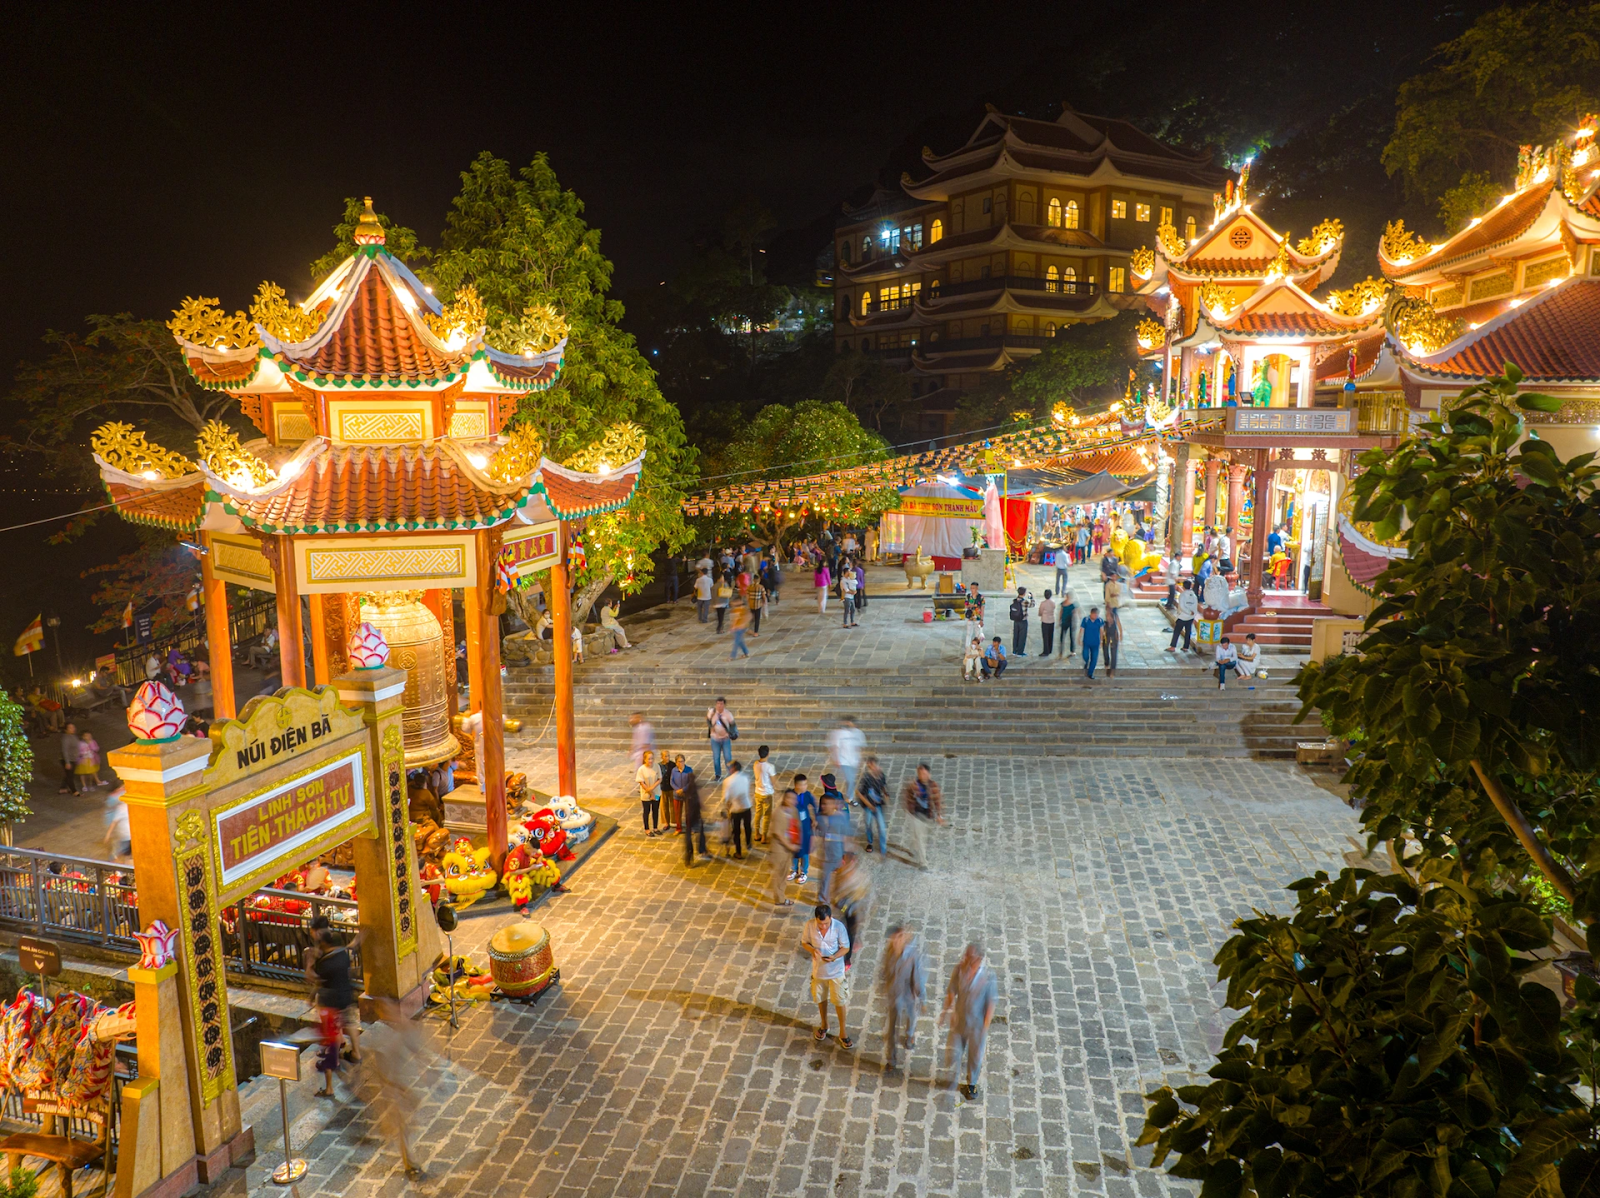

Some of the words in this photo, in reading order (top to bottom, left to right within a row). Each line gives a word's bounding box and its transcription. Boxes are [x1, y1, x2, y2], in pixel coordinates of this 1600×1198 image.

[909, 500, 917, 509] BÀ
[236, 738, 266, 769] NÚI
[270, 726, 307, 756] ĐIỆN
[258, 794, 292, 822] LINH
[296, 778, 325, 804] SƠN
